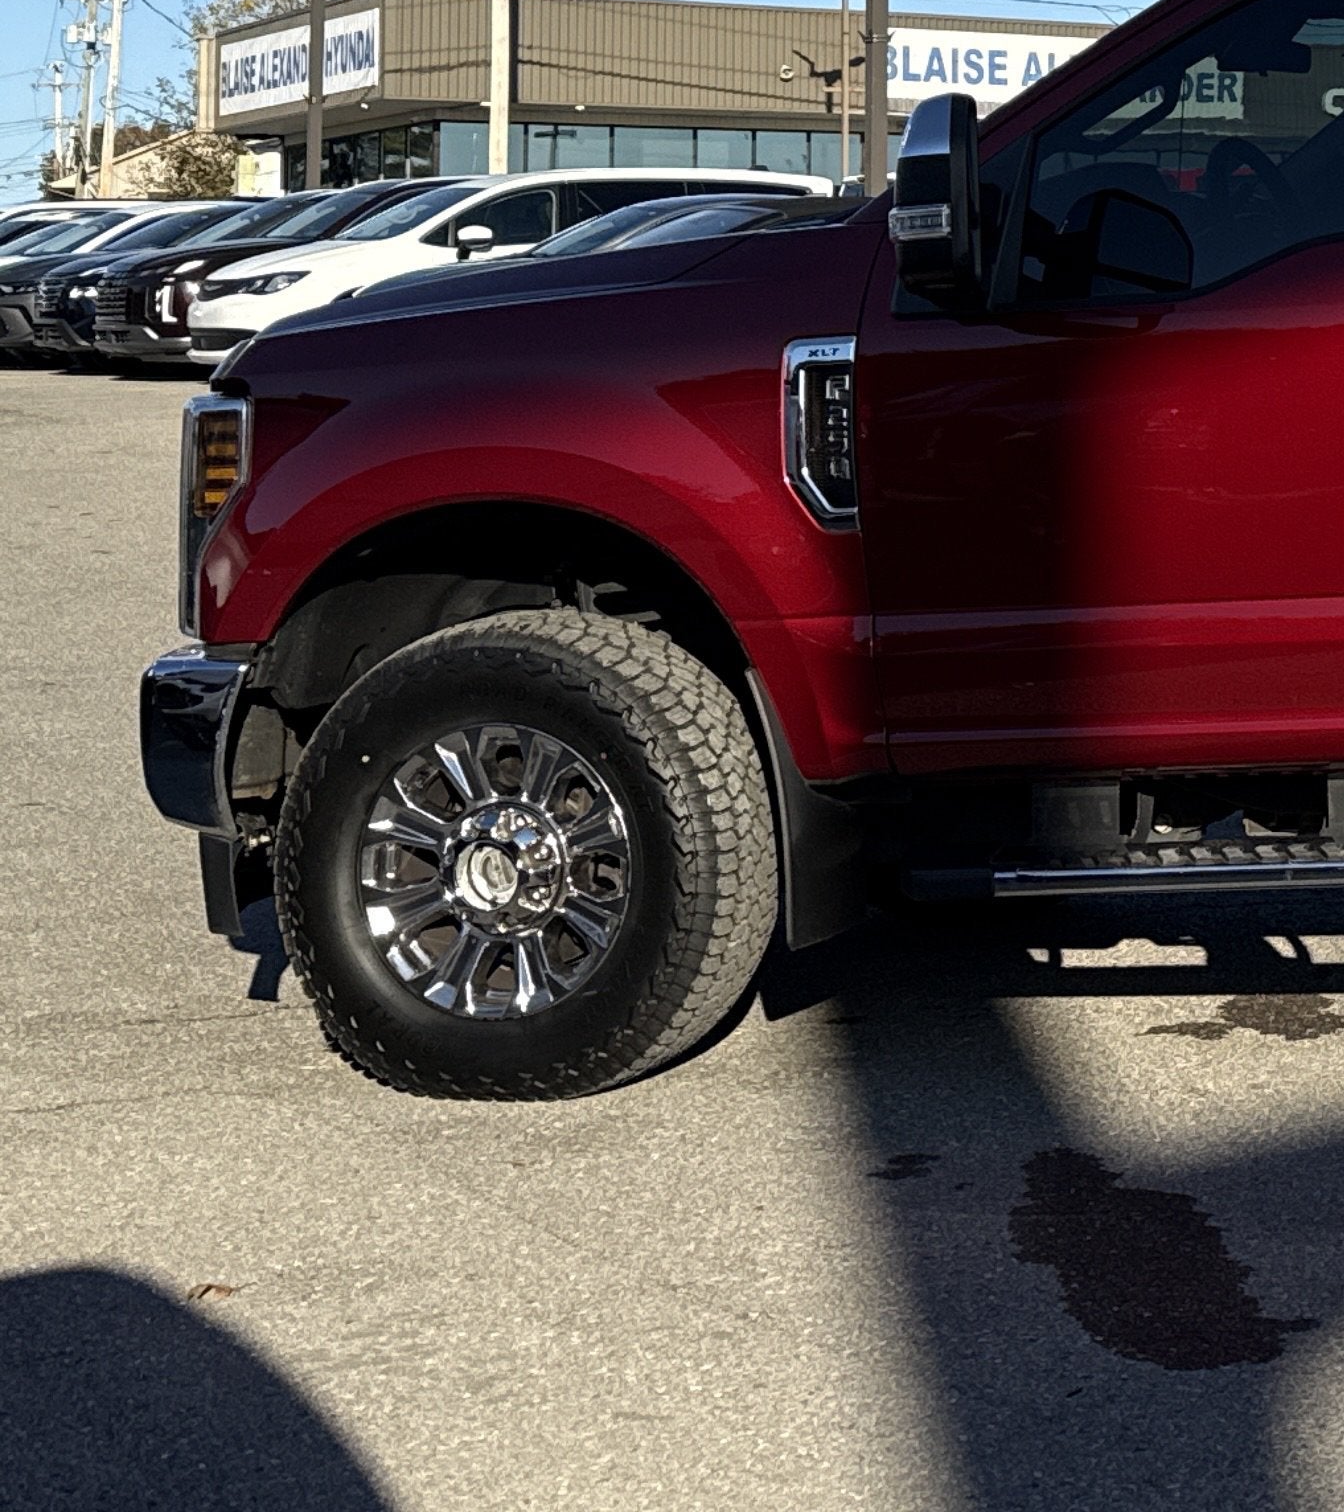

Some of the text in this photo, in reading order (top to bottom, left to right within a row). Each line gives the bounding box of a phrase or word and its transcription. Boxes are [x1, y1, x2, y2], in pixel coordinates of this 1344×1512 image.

[221, 26, 375, 99] BLAISE ALEXAND HYUNDAI
[807, 346, 841, 358] XLT
